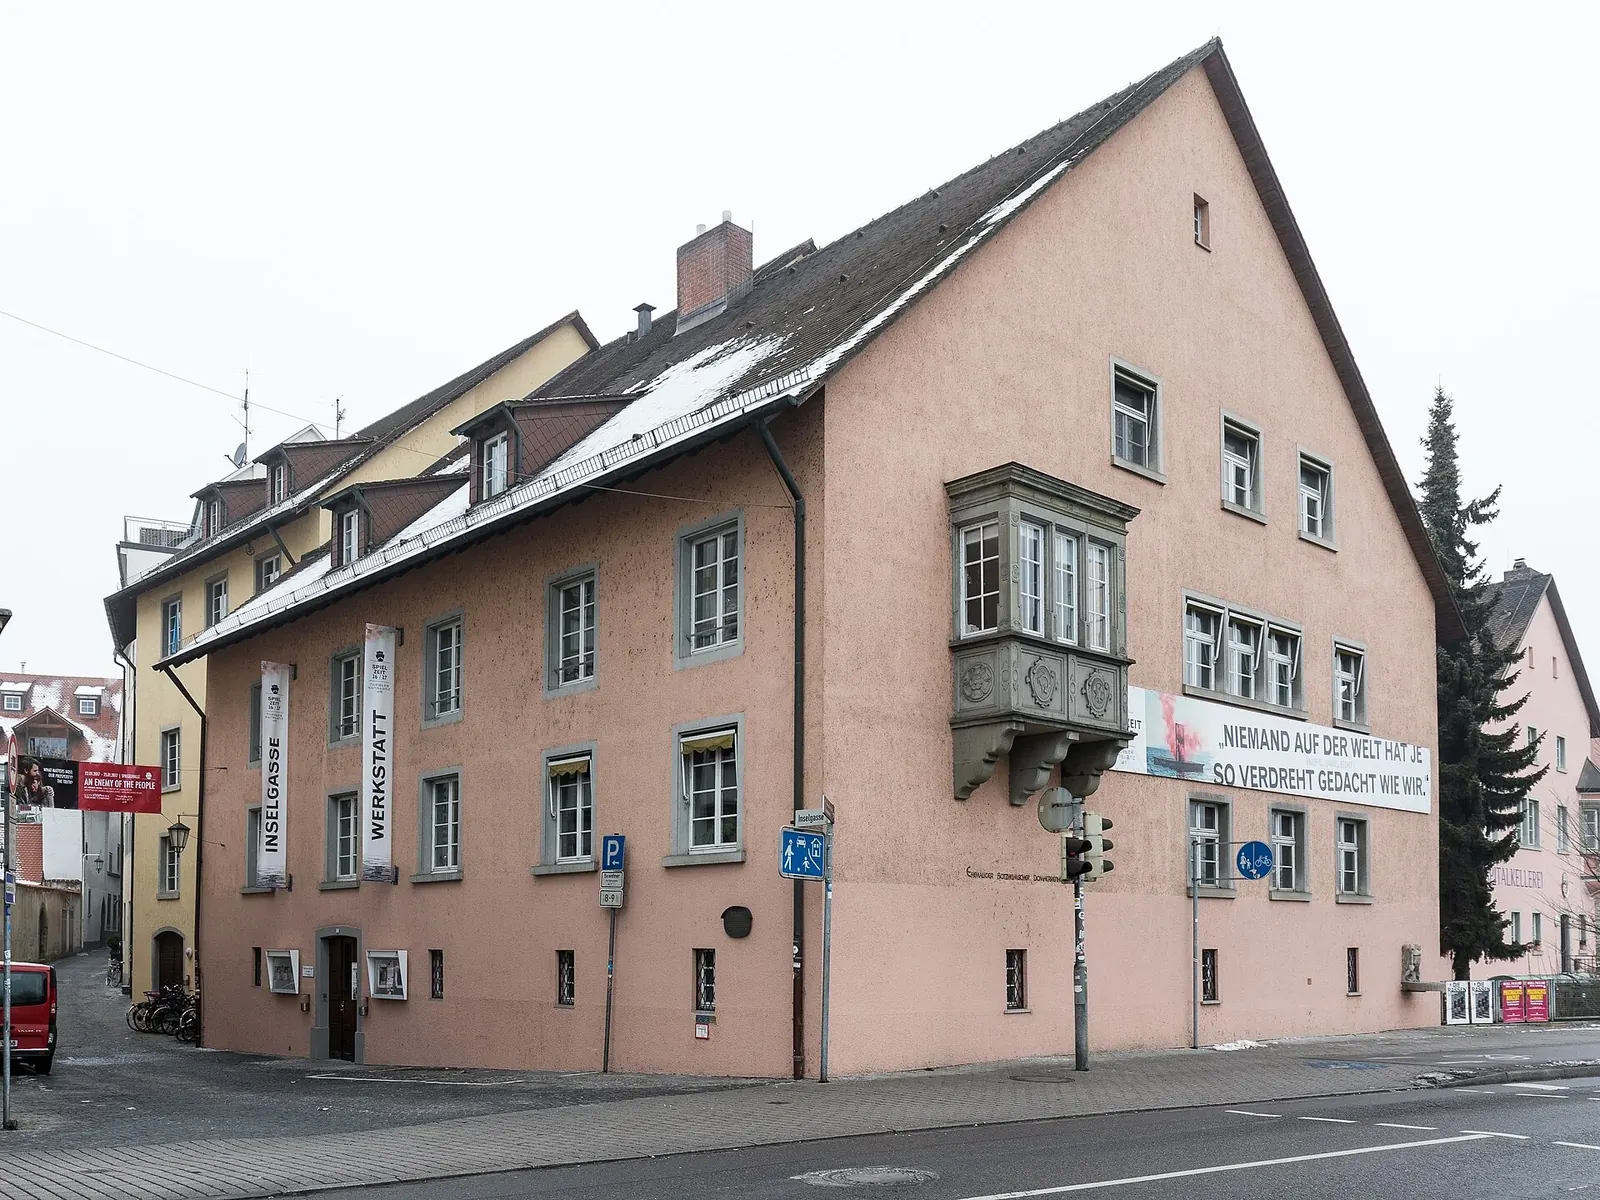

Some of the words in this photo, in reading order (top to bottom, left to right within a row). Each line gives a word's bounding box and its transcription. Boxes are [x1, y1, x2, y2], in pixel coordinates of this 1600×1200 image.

[1294, 732, 1319, 755] AUF
[1323, 734, 1348, 757] DER
[1351, 737, 1382, 760] WELT
[1385, 741, 1407, 762] HAT
[1410, 745, 1422, 764] JE
[84, 778, 93, 786] AN
[94, 778, 114, 787] ENEMY
[114, 779, 122, 788] OF
[123, 780, 134, 789] THE
[135, 781, 155, 790] PEOPLE
[371, 709, 387, 840] WERKSTATT
[1213, 762, 1235, 786] SO
[1239, 764, 1315, 790] VERDREHT
[1318, 769, 1376, 793] GEDACHT
[1380, 774, 1399, 795] WIE
[265, 737, 280, 853] INSELGASSE
[798, 812, 824, 823] Inselgasse
[606, 840, 619, 866] P
